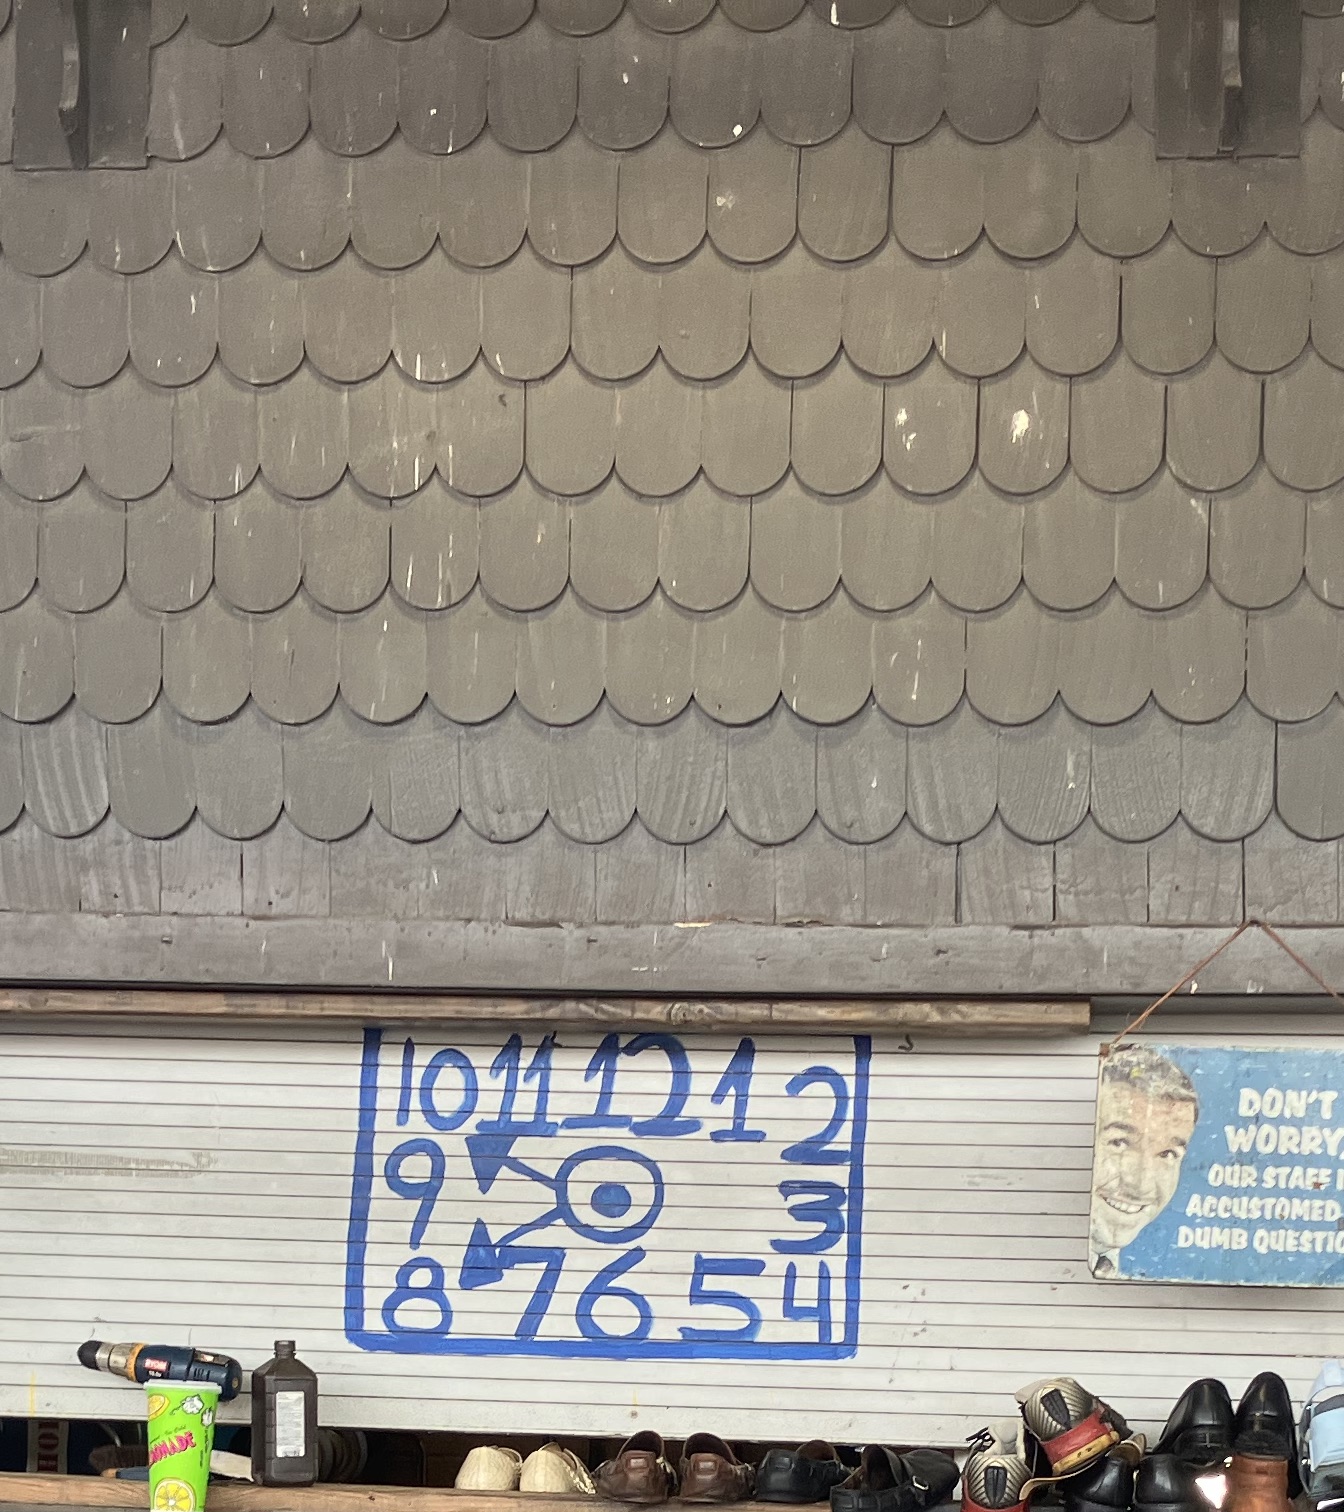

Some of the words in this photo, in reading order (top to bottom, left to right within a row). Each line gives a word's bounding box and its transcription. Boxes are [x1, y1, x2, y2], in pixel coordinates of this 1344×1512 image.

[396, 1037, 479, 1131] 10
[475, 1033, 559, 1136] 11
[558, 1032, 705, 1137] 12
[709, 1037, 767, 1142] 1
[780, 1065, 852, 1165] 2
[1238, 1087, 1339, 1120] DON'T
[384, 1137, 446, 1250] 9
[1207, 1163, 1258, 1188] OUR
[1261, 1165, 1333, 1190] STAFF
[769, 1180, 847, 1254] 3
[1185, 1194, 1343, 1223] ACCUSTOMED
[1177, 1226, 1249, 1250] DUMB
[381, 1256, 453, 1338] 8
[496, 1245, 567, 1341] 7
[575, 1246, 655, 1341] 6
[678, 1253, 767, 1341] 5
[782, 1260, 832, 1343] 4
